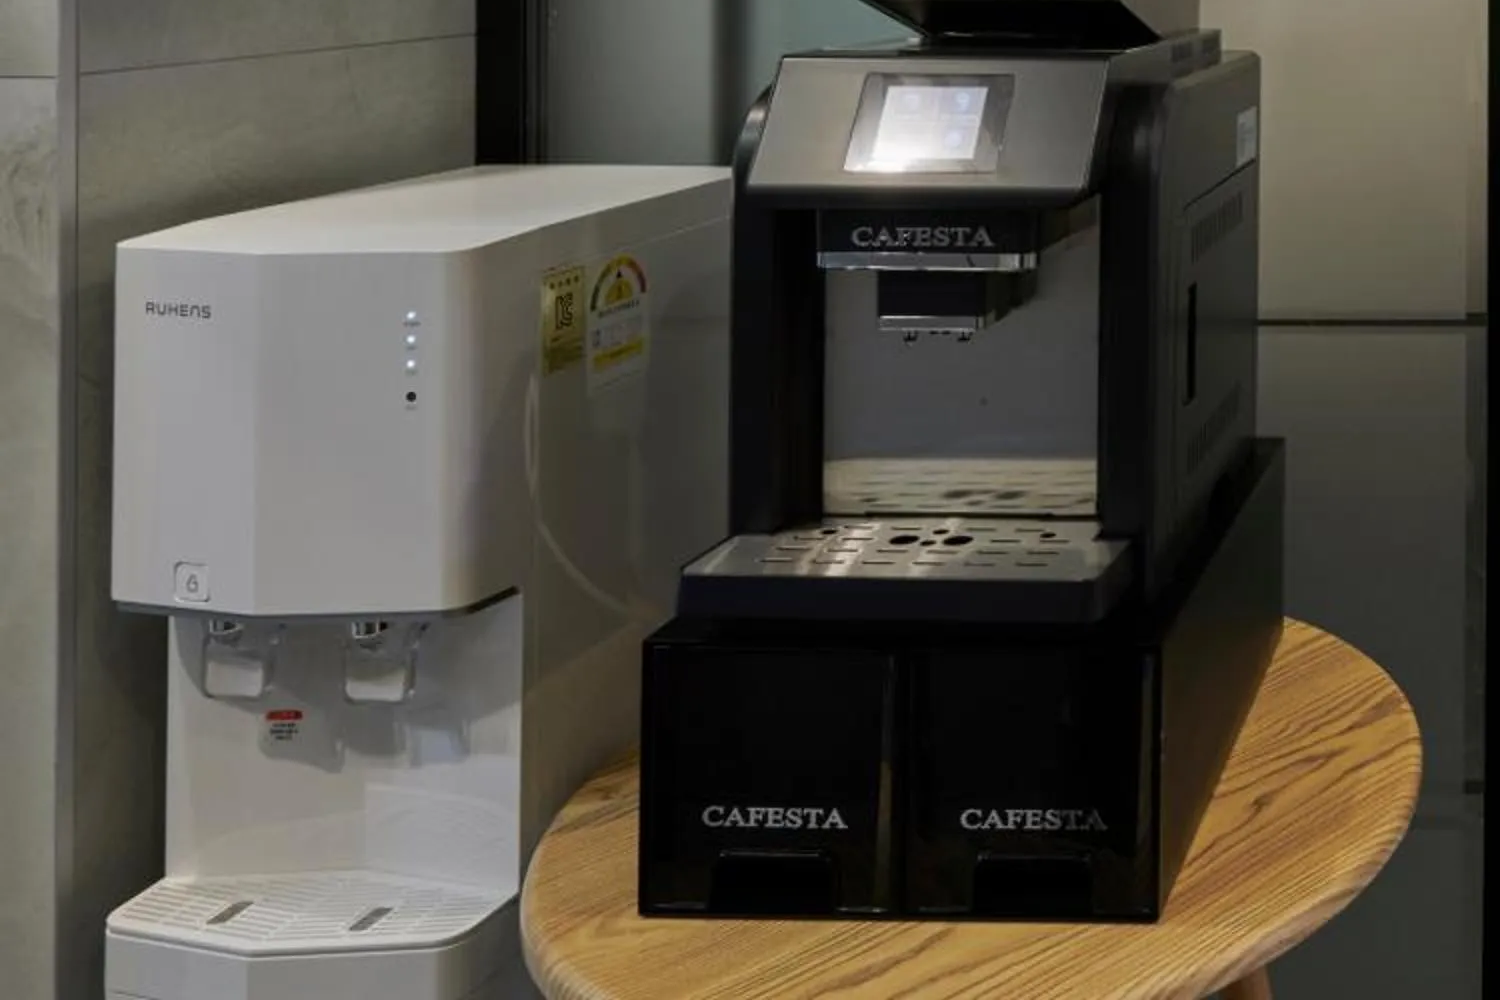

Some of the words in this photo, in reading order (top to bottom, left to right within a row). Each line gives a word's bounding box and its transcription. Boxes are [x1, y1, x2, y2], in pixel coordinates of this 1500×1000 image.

[851, 226, 996, 247] CAFESTA
[701, 805, 849, 829] CAFESTA
[959, 808, 1108, 830] CAFESTA
